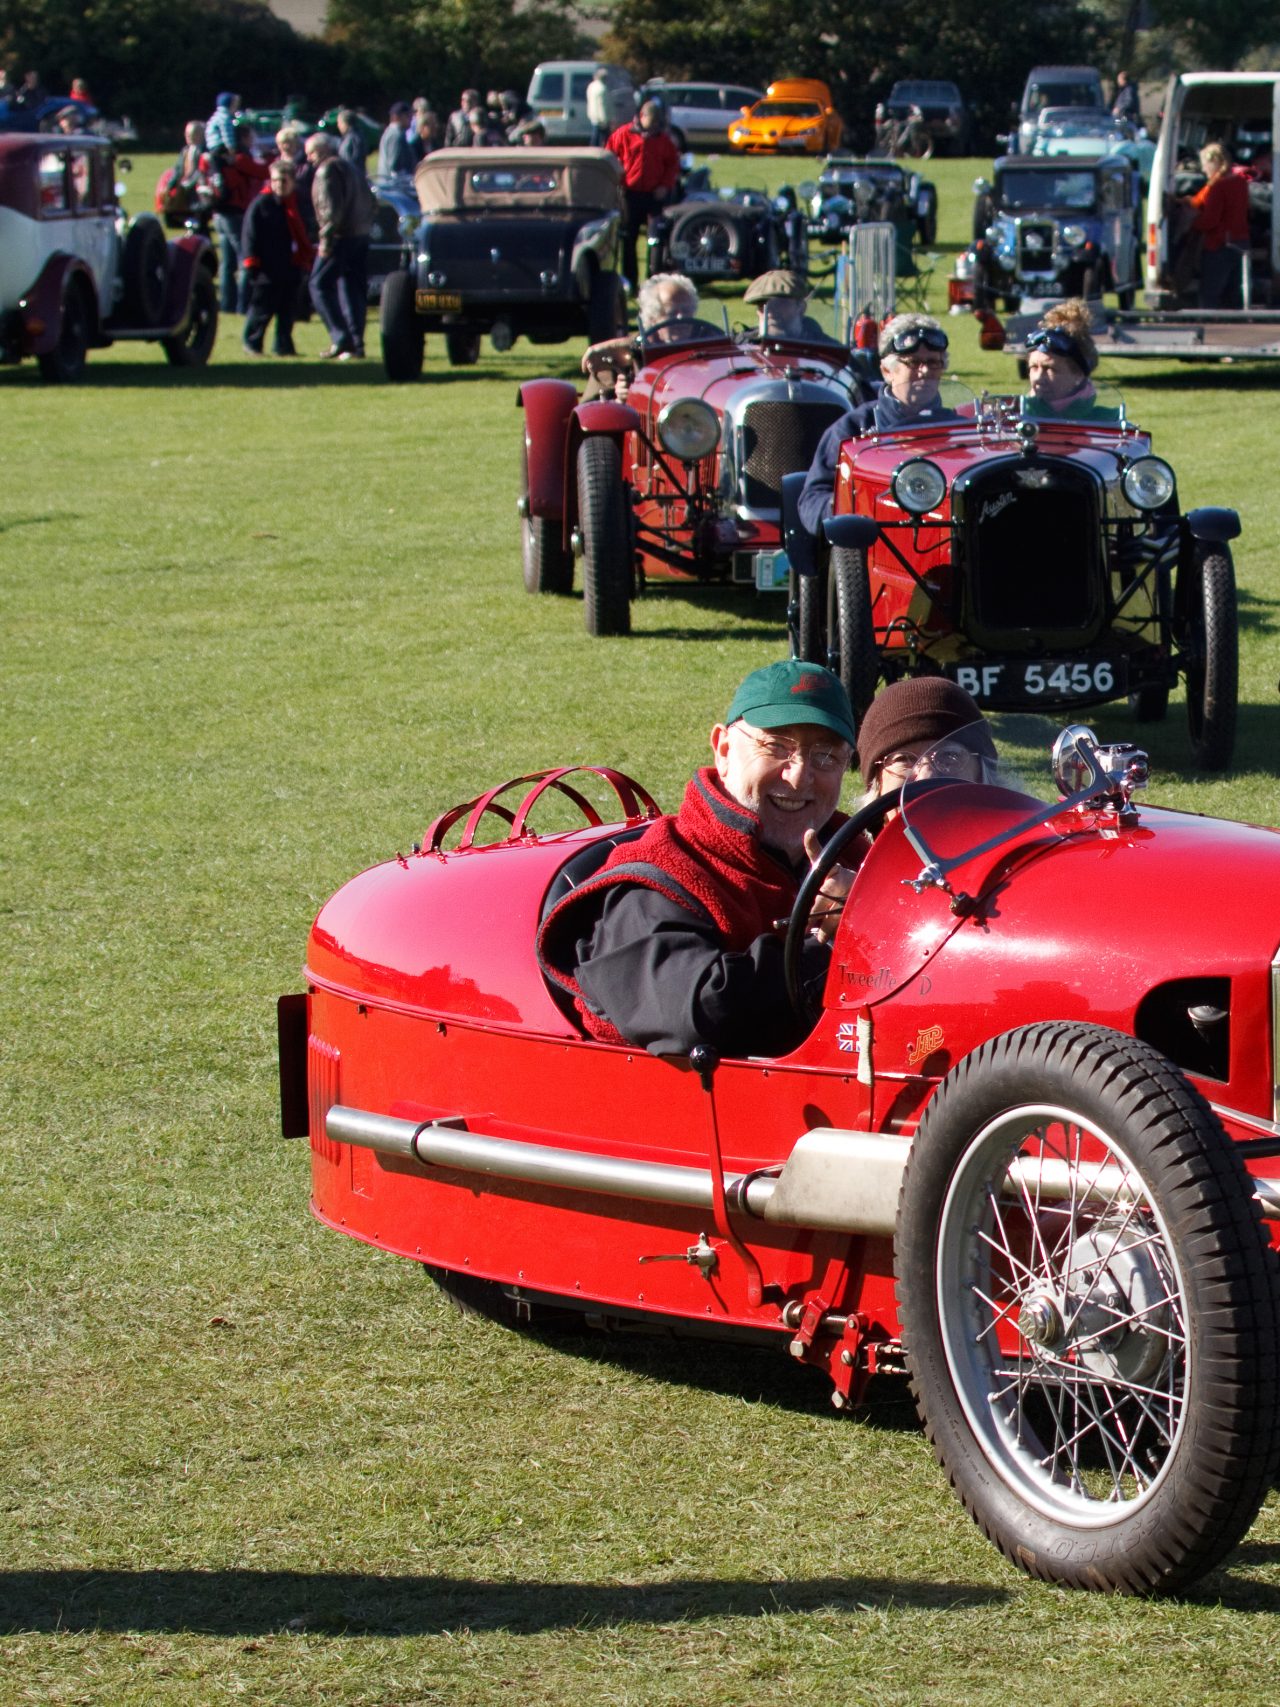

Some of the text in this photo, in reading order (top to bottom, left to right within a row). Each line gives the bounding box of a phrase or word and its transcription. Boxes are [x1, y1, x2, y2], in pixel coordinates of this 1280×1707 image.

[979, 491, 1017, 524] Austin
[957, 662, 1114, 696] BF 5456
[838, 963, 897, 991] Tweedle
[908, 1024, 945, 1066] JAP
